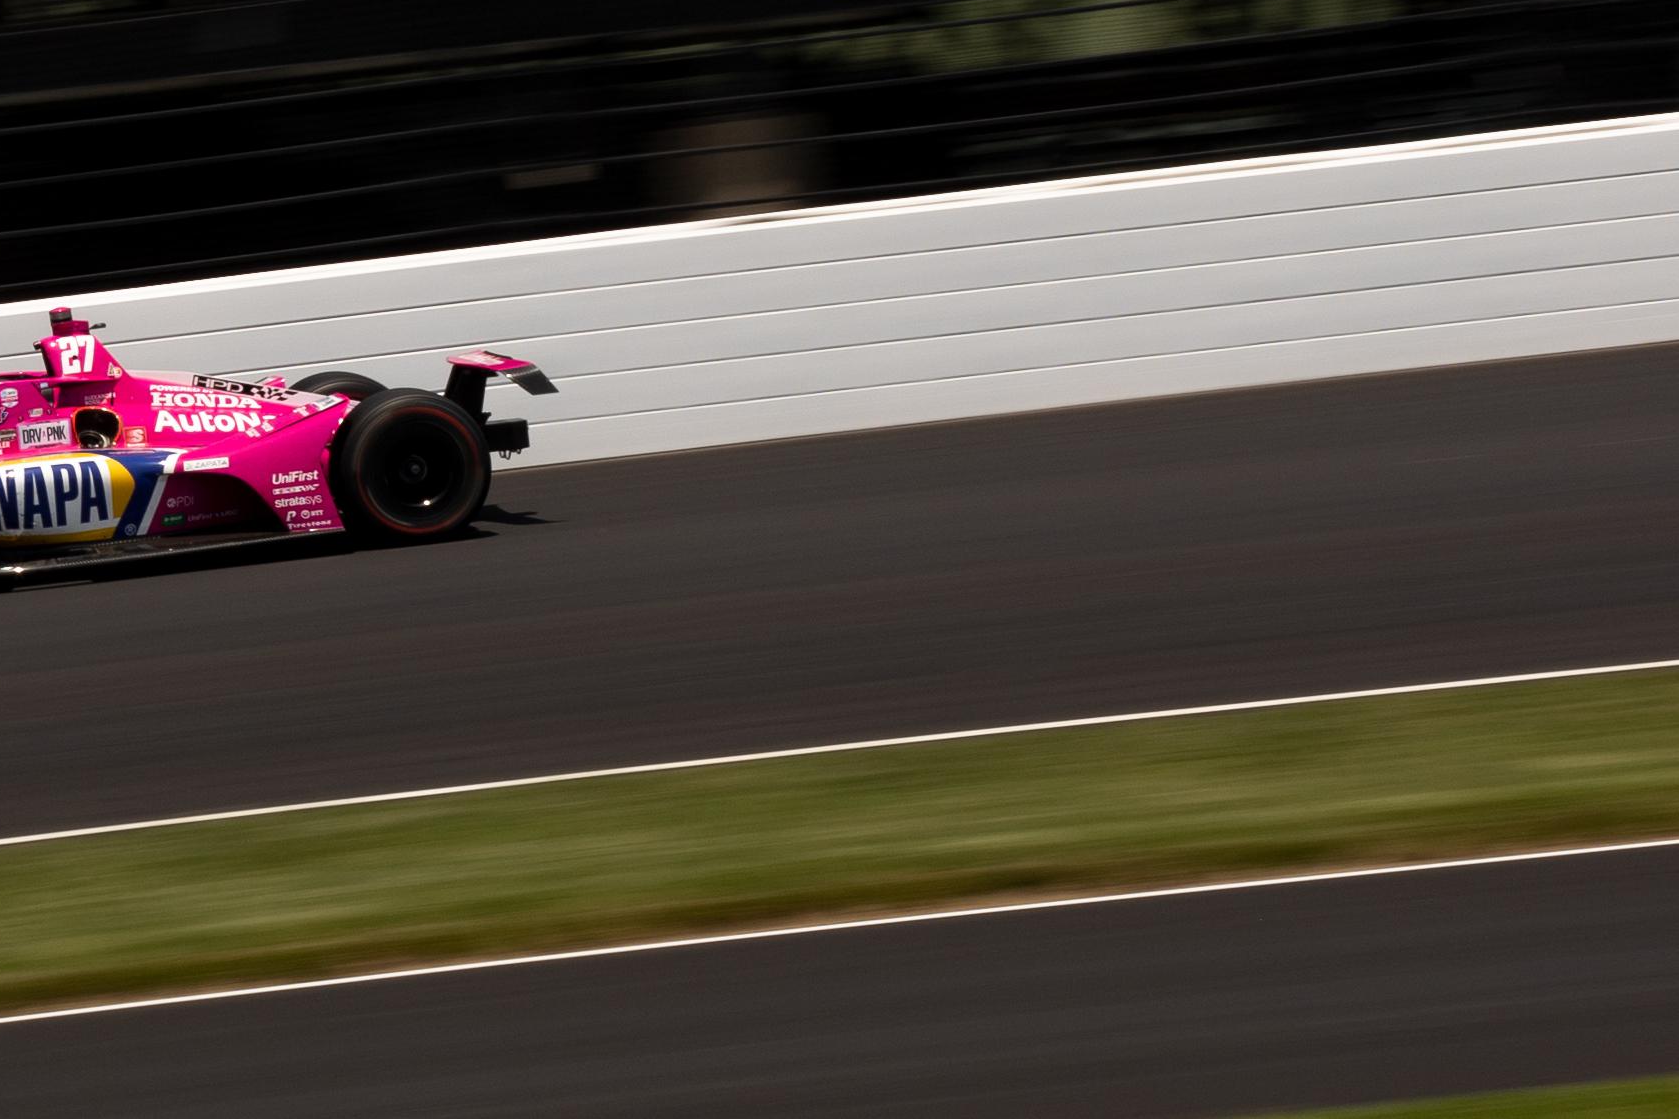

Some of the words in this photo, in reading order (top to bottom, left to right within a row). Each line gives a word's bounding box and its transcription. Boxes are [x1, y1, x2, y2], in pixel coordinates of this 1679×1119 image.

[58, 335, 95, 375] 27
[194, 377, 244, 393] HPD
[150, 391, 262, 409] HONDA
[22, 428, 43, 445] DRV
[47, 425, 67, 442] PNK
[272, 470, 319, 485] UniFirst
[274, 495, 323, 508] stratasys
